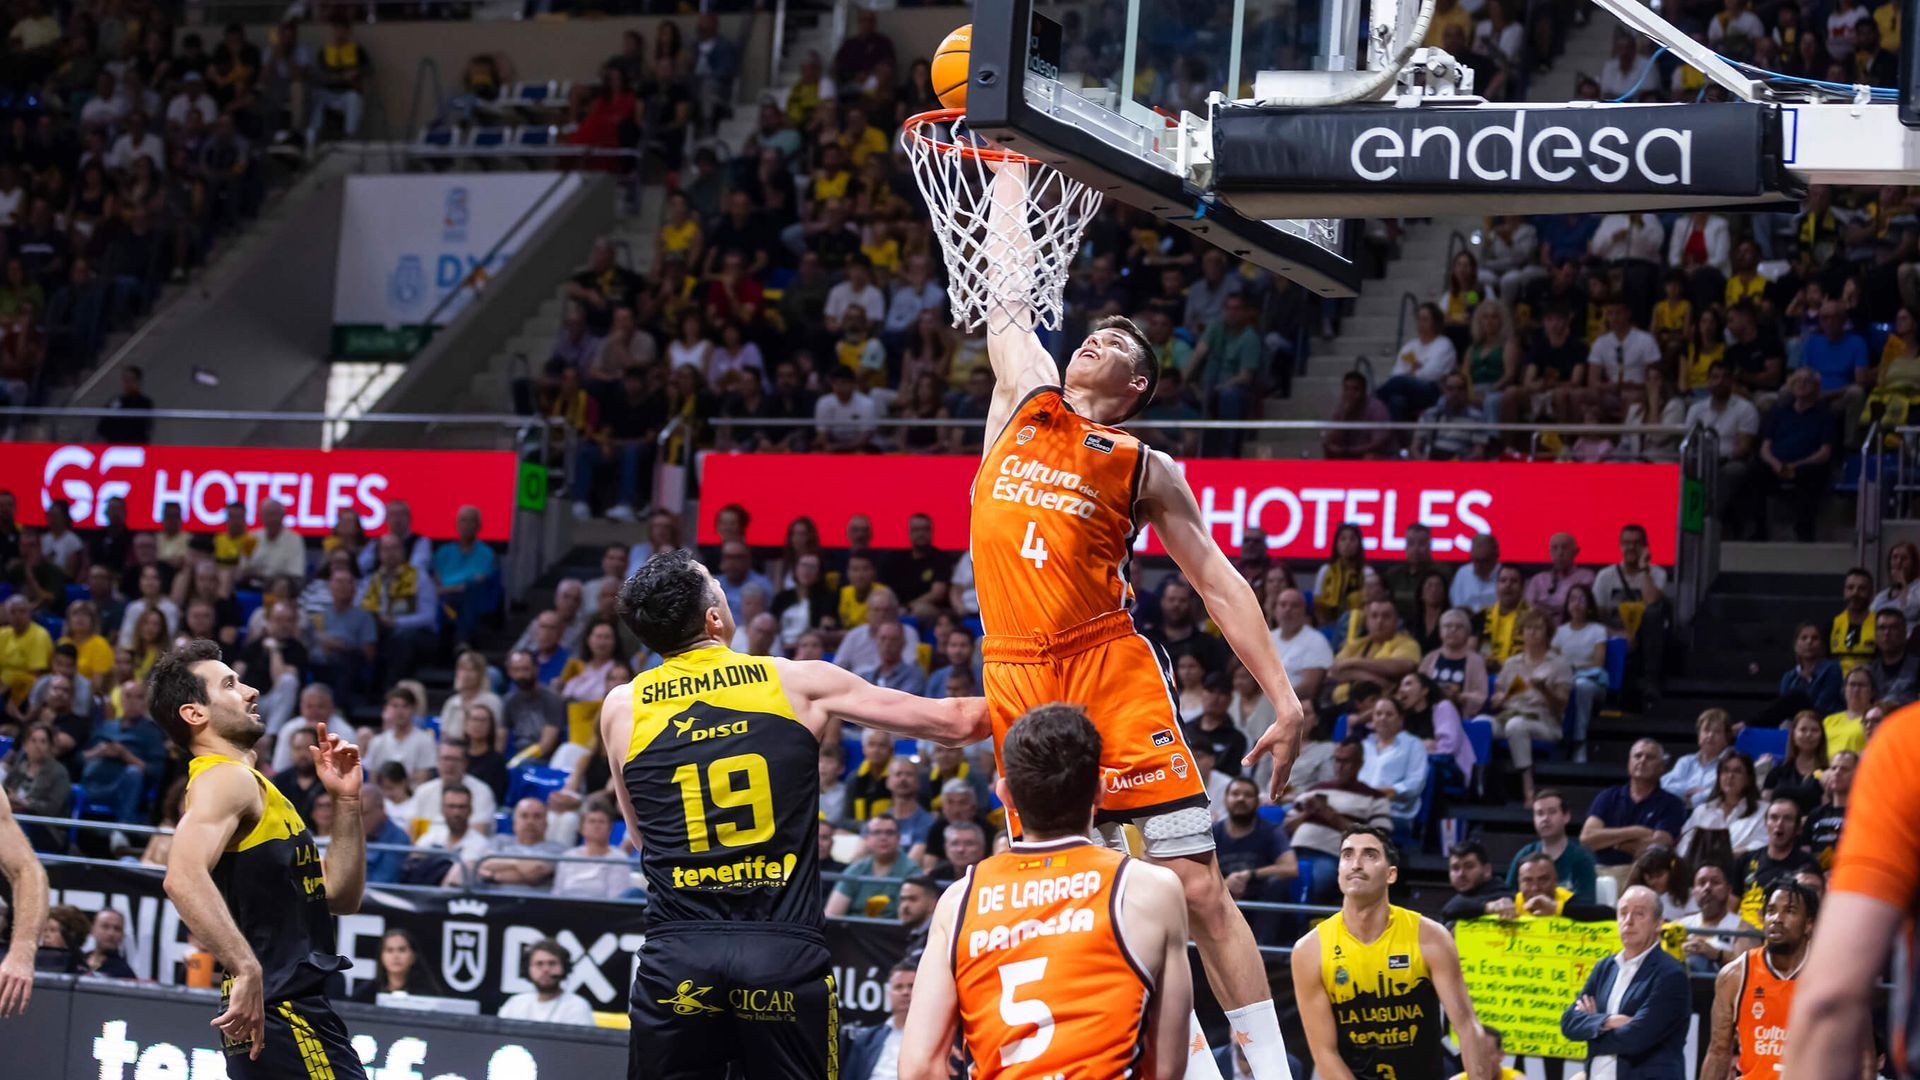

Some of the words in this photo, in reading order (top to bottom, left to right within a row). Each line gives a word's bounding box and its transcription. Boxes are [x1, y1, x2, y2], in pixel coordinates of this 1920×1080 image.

[1028, 53, 1058, 80] desa
[1350, 110, 1692, 185] endesa
[992, 476, 1096, 519] Esfuerzo
[1000, 455, 1081, 490] Cultura
[1079, 484, 1099, 499] del
[152, 469, 388, 531] HOTELES
[1201, 486, 1493, 552] HOTELES
[1020, 521, 1048, 569] 4
[642, 664, 769, 704] SHERMADINI
[1155, 736, 1170, 745] acb
[1107, 769, 1166, 790] Midea
[671, 752, 776, 853] 19
[977, 884, 1005, 915] DE
[1011, 870, 1101, 908] LARREA
[729, 989, 797, 1013] CICAR
[998, 956, 1056, 1068] 5
[1339, 1010, 1360, 1024] LA
[1361, 1004, 1424, 1022] LAGUNA
